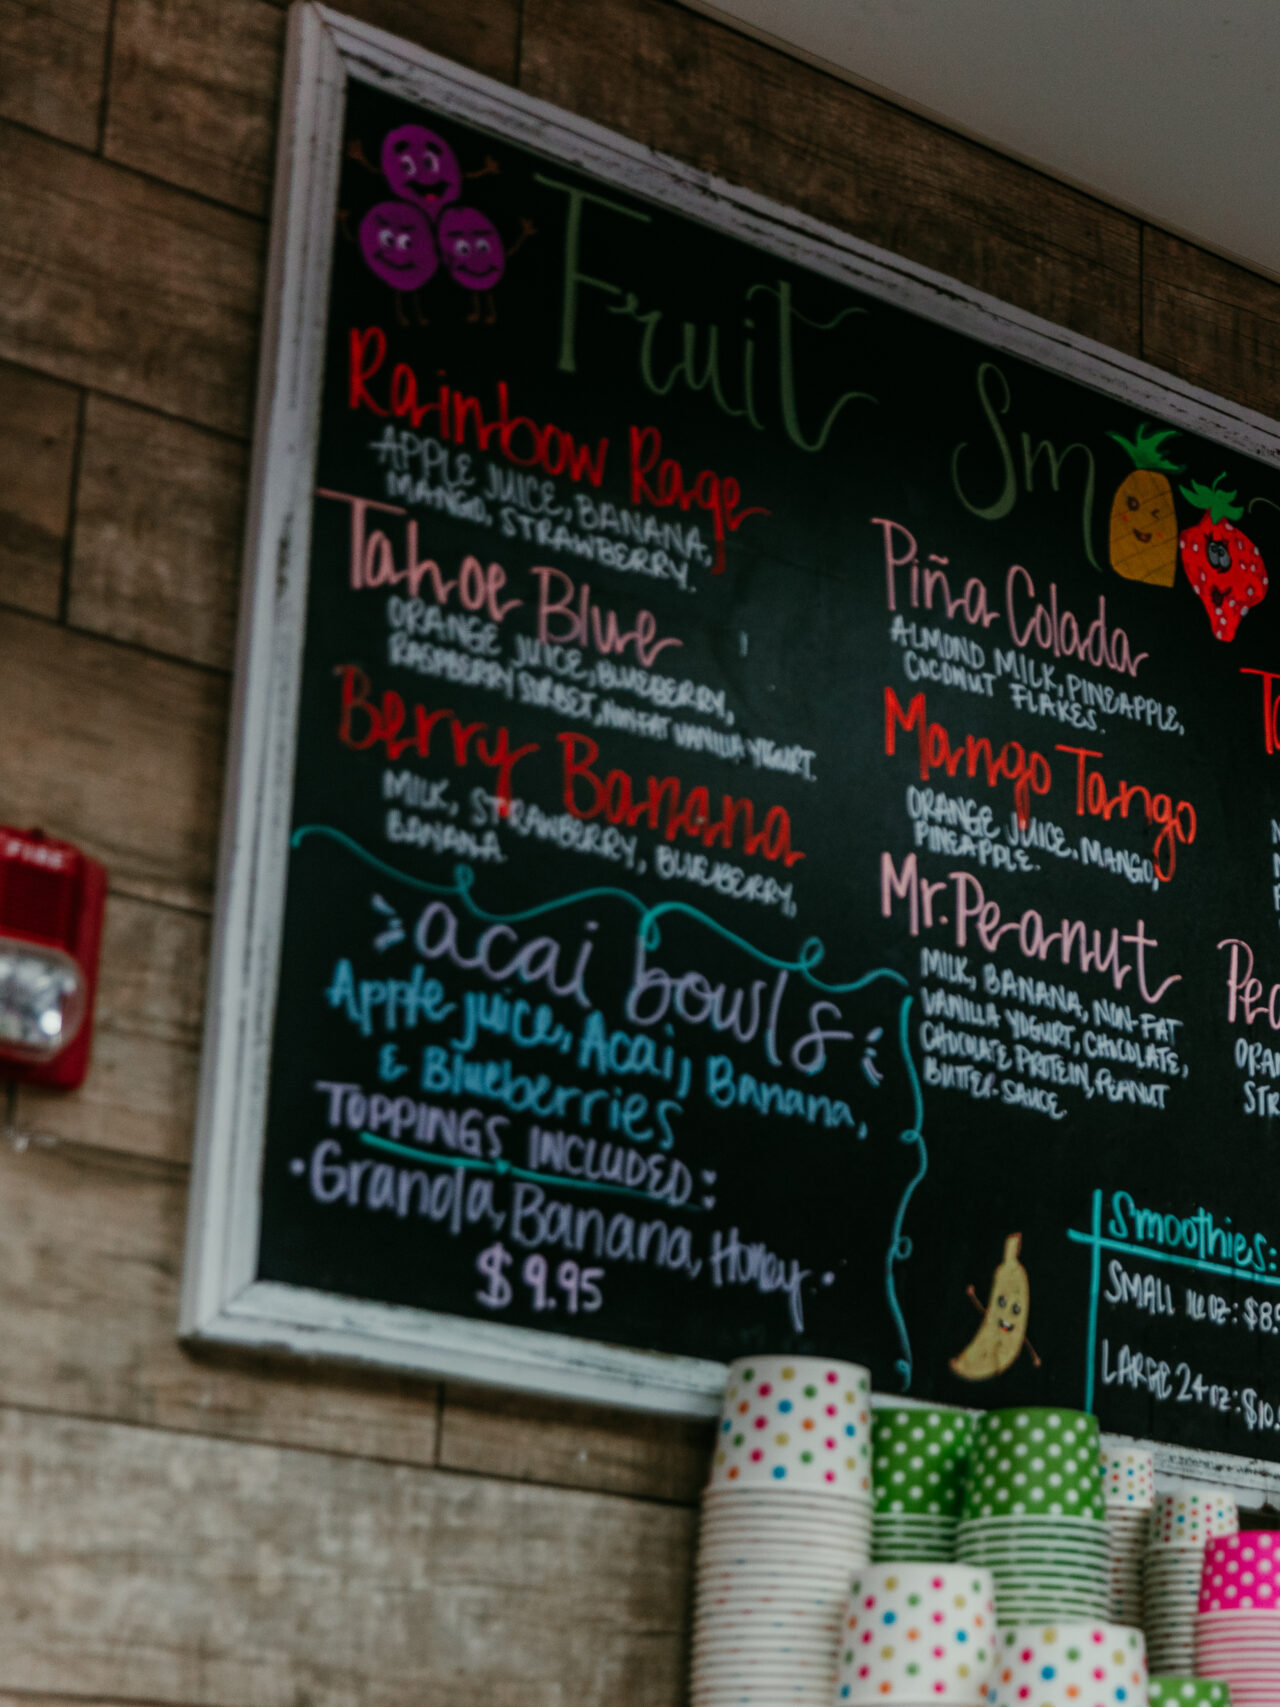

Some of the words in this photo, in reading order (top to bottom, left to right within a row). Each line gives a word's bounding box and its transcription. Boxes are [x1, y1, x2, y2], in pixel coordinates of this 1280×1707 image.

[533, 172, 880, 453] Fruit
[349, 325, 609, 487] Rainbow
[628, 424, 773, 574] Rage
[316, 487, 523, 622] Tahoe
[529, 565, 683, 667] Blue
[1005, 564, 1149, 678] Colada
[890, 615, 986, 672] ALMOND
[904, 650, 996, 697] COCONUT
[333, 665, 540, 819] Berry
[557, 732, 806, 867] Banana
[882, 686, 1052, 829] Mango
[1054, 744, 1197, 882] Tango
[907, 786, 1000, 838] ORANGE
[328, 958, 457, 1036] Apple
[625, 933, 852, 1074] bowls
[316, 1080, 511, 1157] TOPPINGS
[420, 1045, 682, 1151] Blueberries
[1104, 1260, 1175, 1316] SMALL
[1101, 1340, 1171, 1402] LARGE
